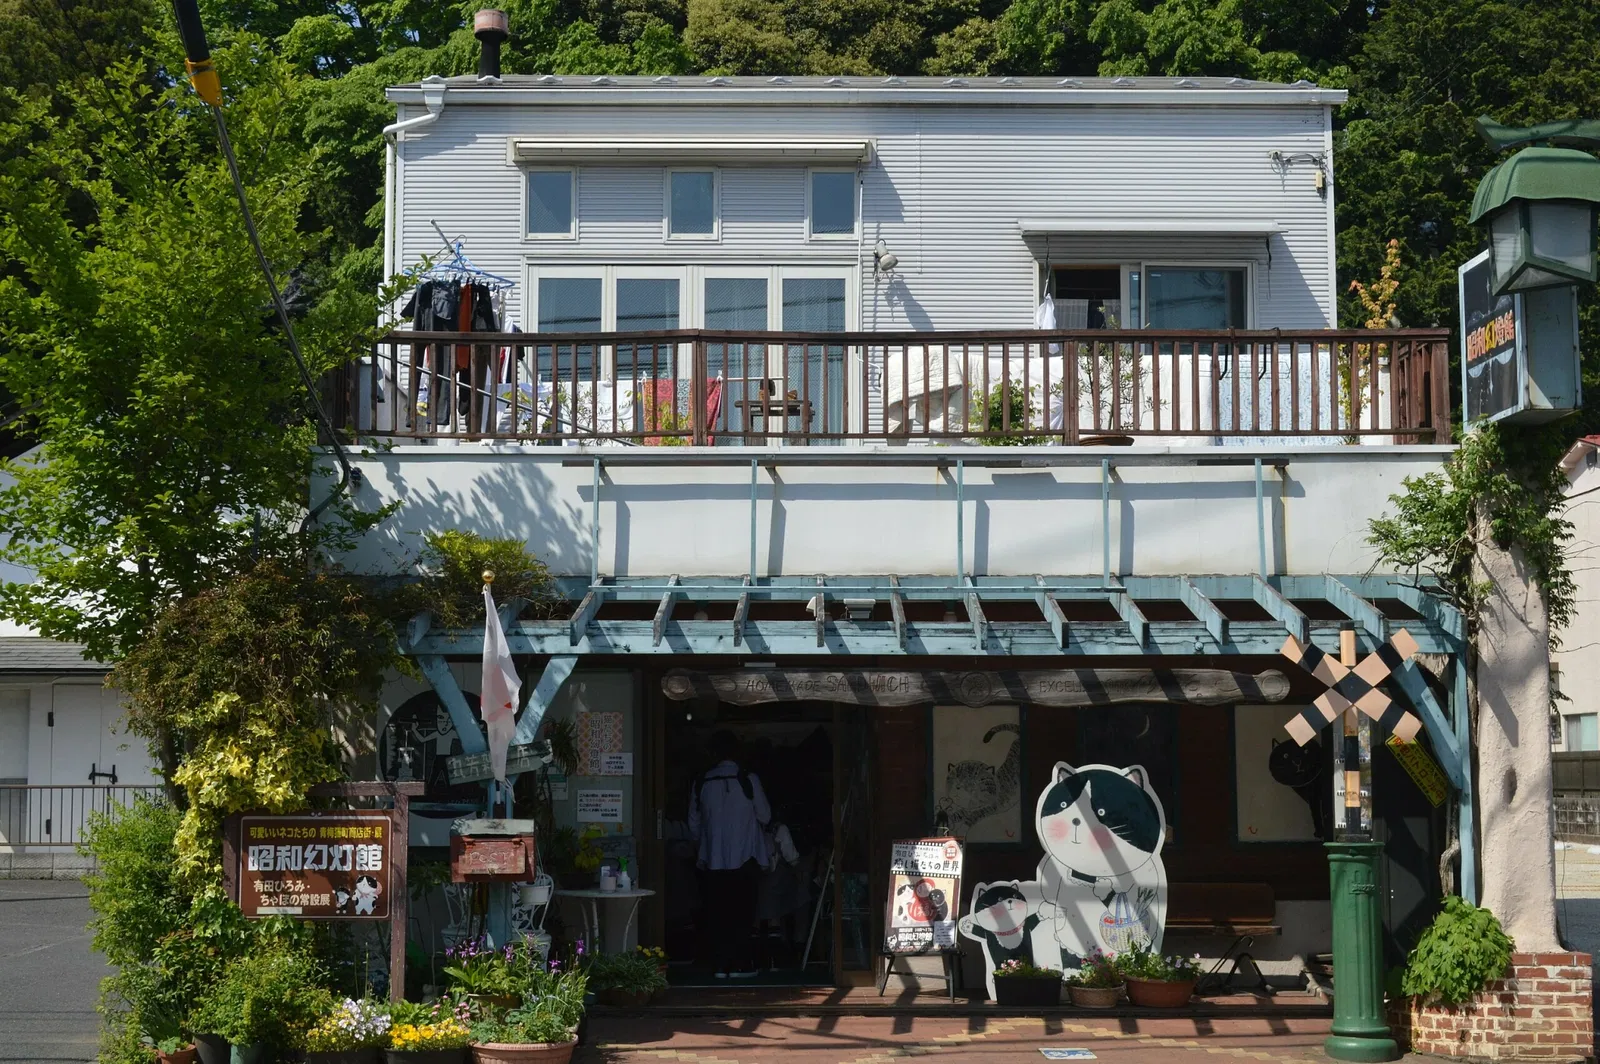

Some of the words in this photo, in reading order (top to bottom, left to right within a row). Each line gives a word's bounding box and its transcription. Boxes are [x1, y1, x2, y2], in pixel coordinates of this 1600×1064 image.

[250, 826, 316, 839] 可愛いいネコたちの
[248, 844, 383, 872] 昭和幻灯館
